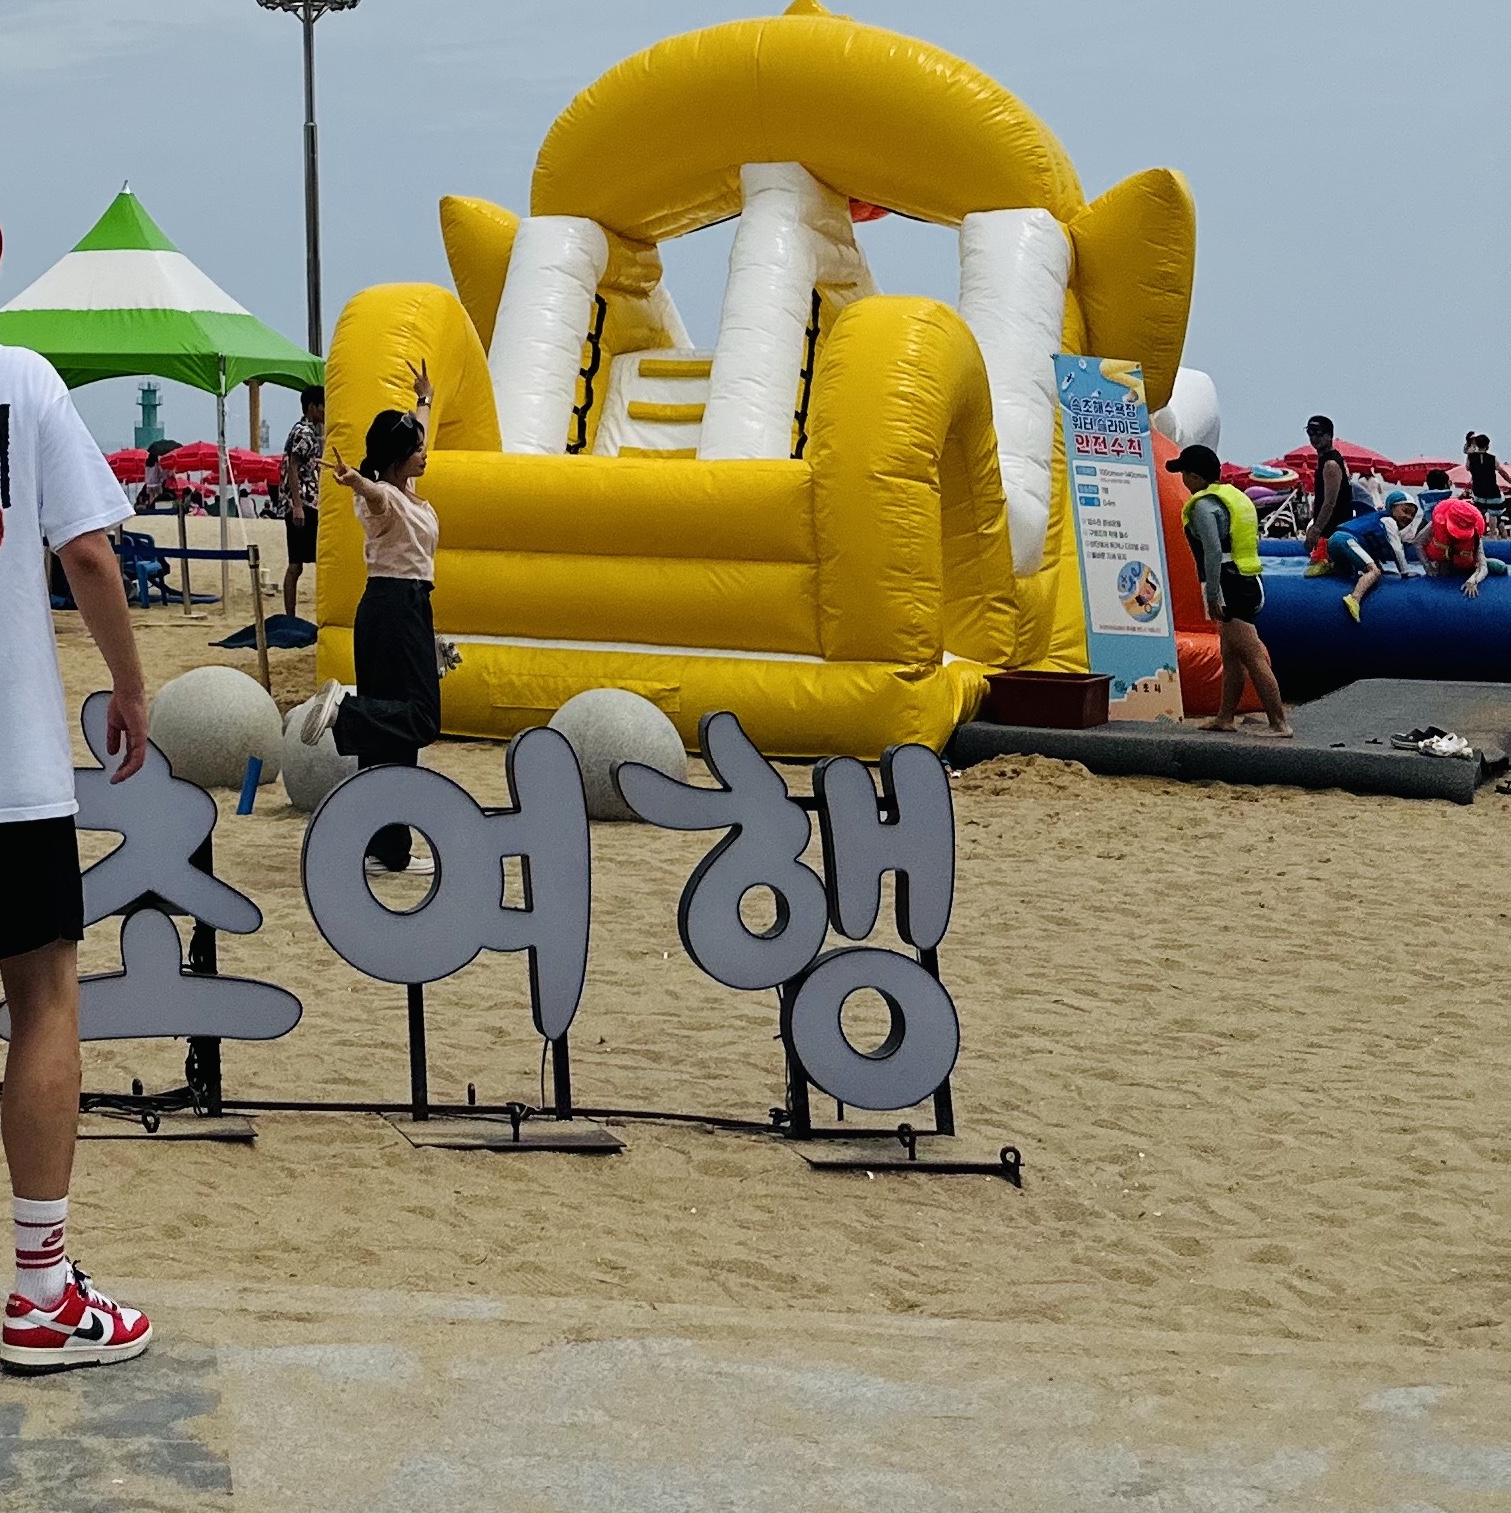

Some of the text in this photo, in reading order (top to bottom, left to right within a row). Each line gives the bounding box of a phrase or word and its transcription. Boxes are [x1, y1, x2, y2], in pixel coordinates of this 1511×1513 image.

[1070, 397, 1137, 418] 속초해수욕장
[1071, 415, 1141, 435] 워터 슬라이드
[1074, 433, 1143, 459] 안전수칙
